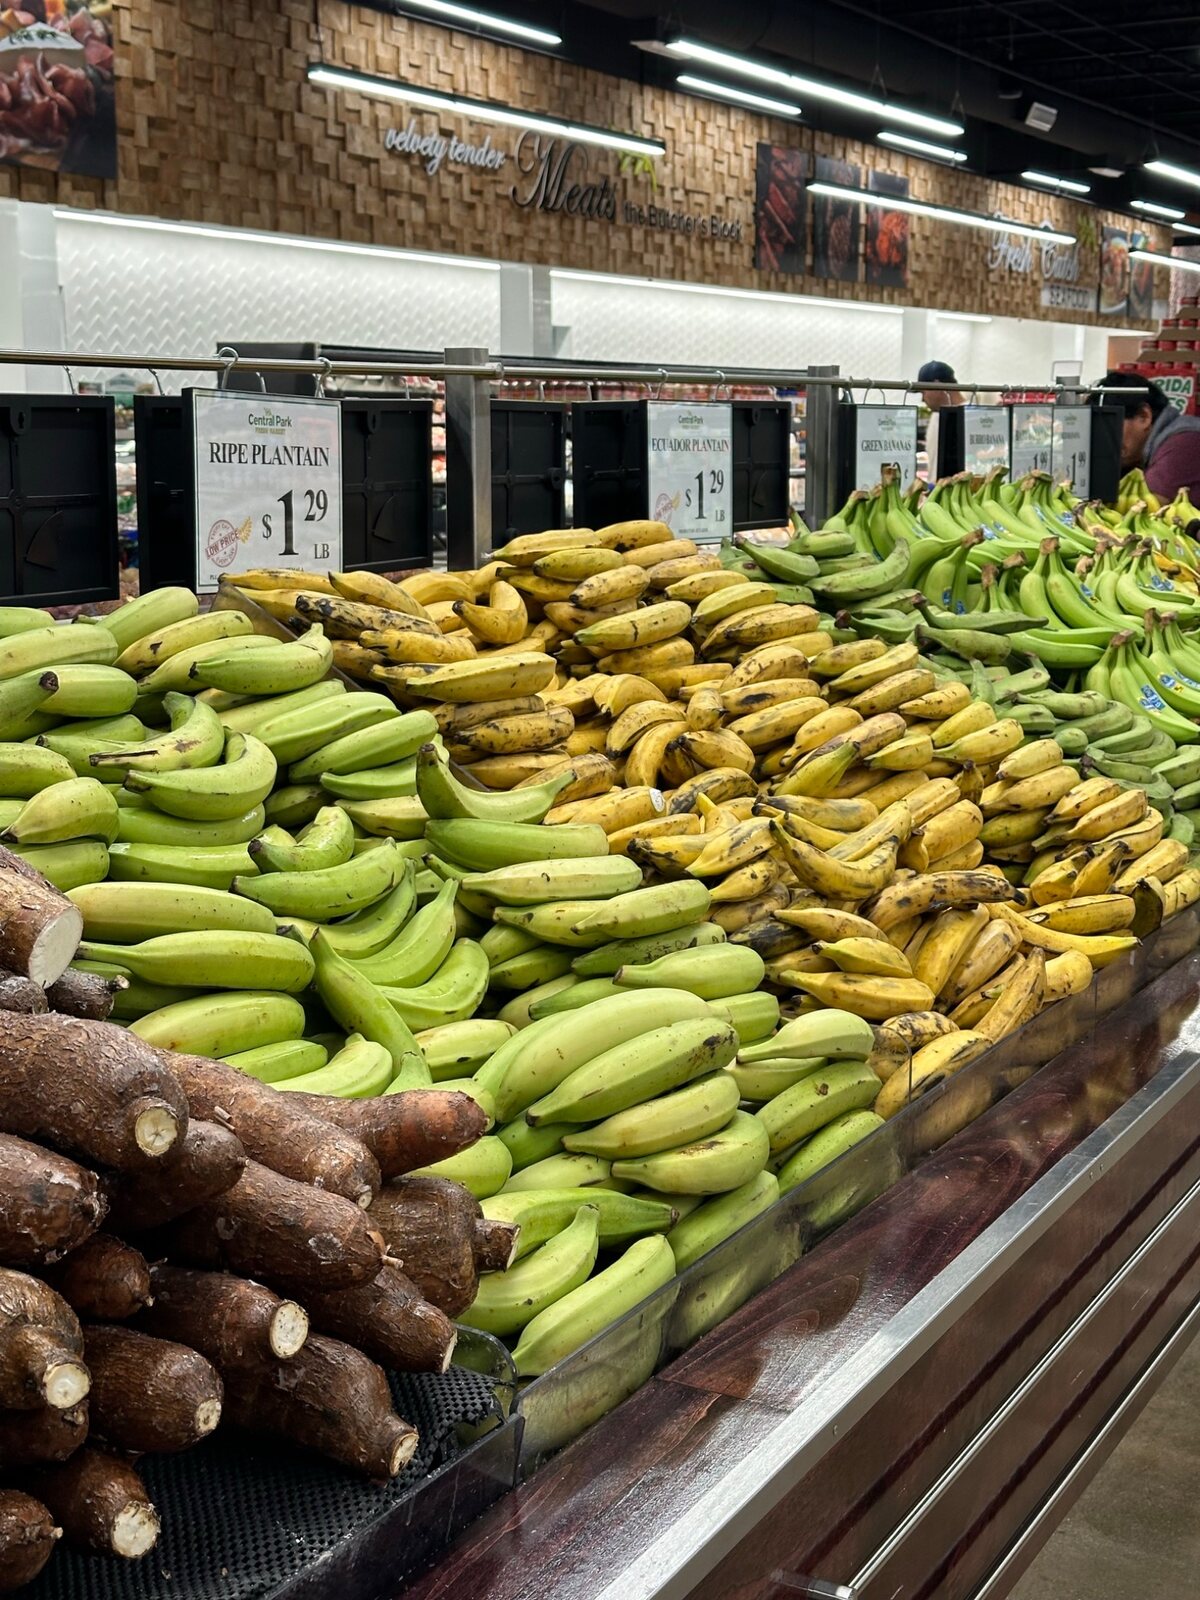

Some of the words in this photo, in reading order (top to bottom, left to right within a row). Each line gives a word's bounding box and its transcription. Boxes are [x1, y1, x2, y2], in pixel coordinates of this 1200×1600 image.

[385, 117, 447, 176] velvety
[447, 135, 506, 169] tender
[508, 130, 617, 219] Meats
[624, 201, 646, 225] the
[710, 214, 744, 242] Block
[248, 413, 275, 426] Central
[276, 415, 292, 427] Park
[209, 442, 248, 464] RIPE
[252, 444, 329, 466] PLANTAIN
[652, 438, 691, 452] ECUADOR
[692, 439, 729, 452] PLANTAIN
[861, 440, 883, 452] GREEN
[884, 440, 912, 451] BANANAS
[709, 469, 724, 494] 29
[303, 489, 328, 522] 29
[715, 509, 725, 522] LB
[205, 543, 219, 560] LOW
[220, 528, 240, 549] PRICE
[313, 543, 330, 559] LB
